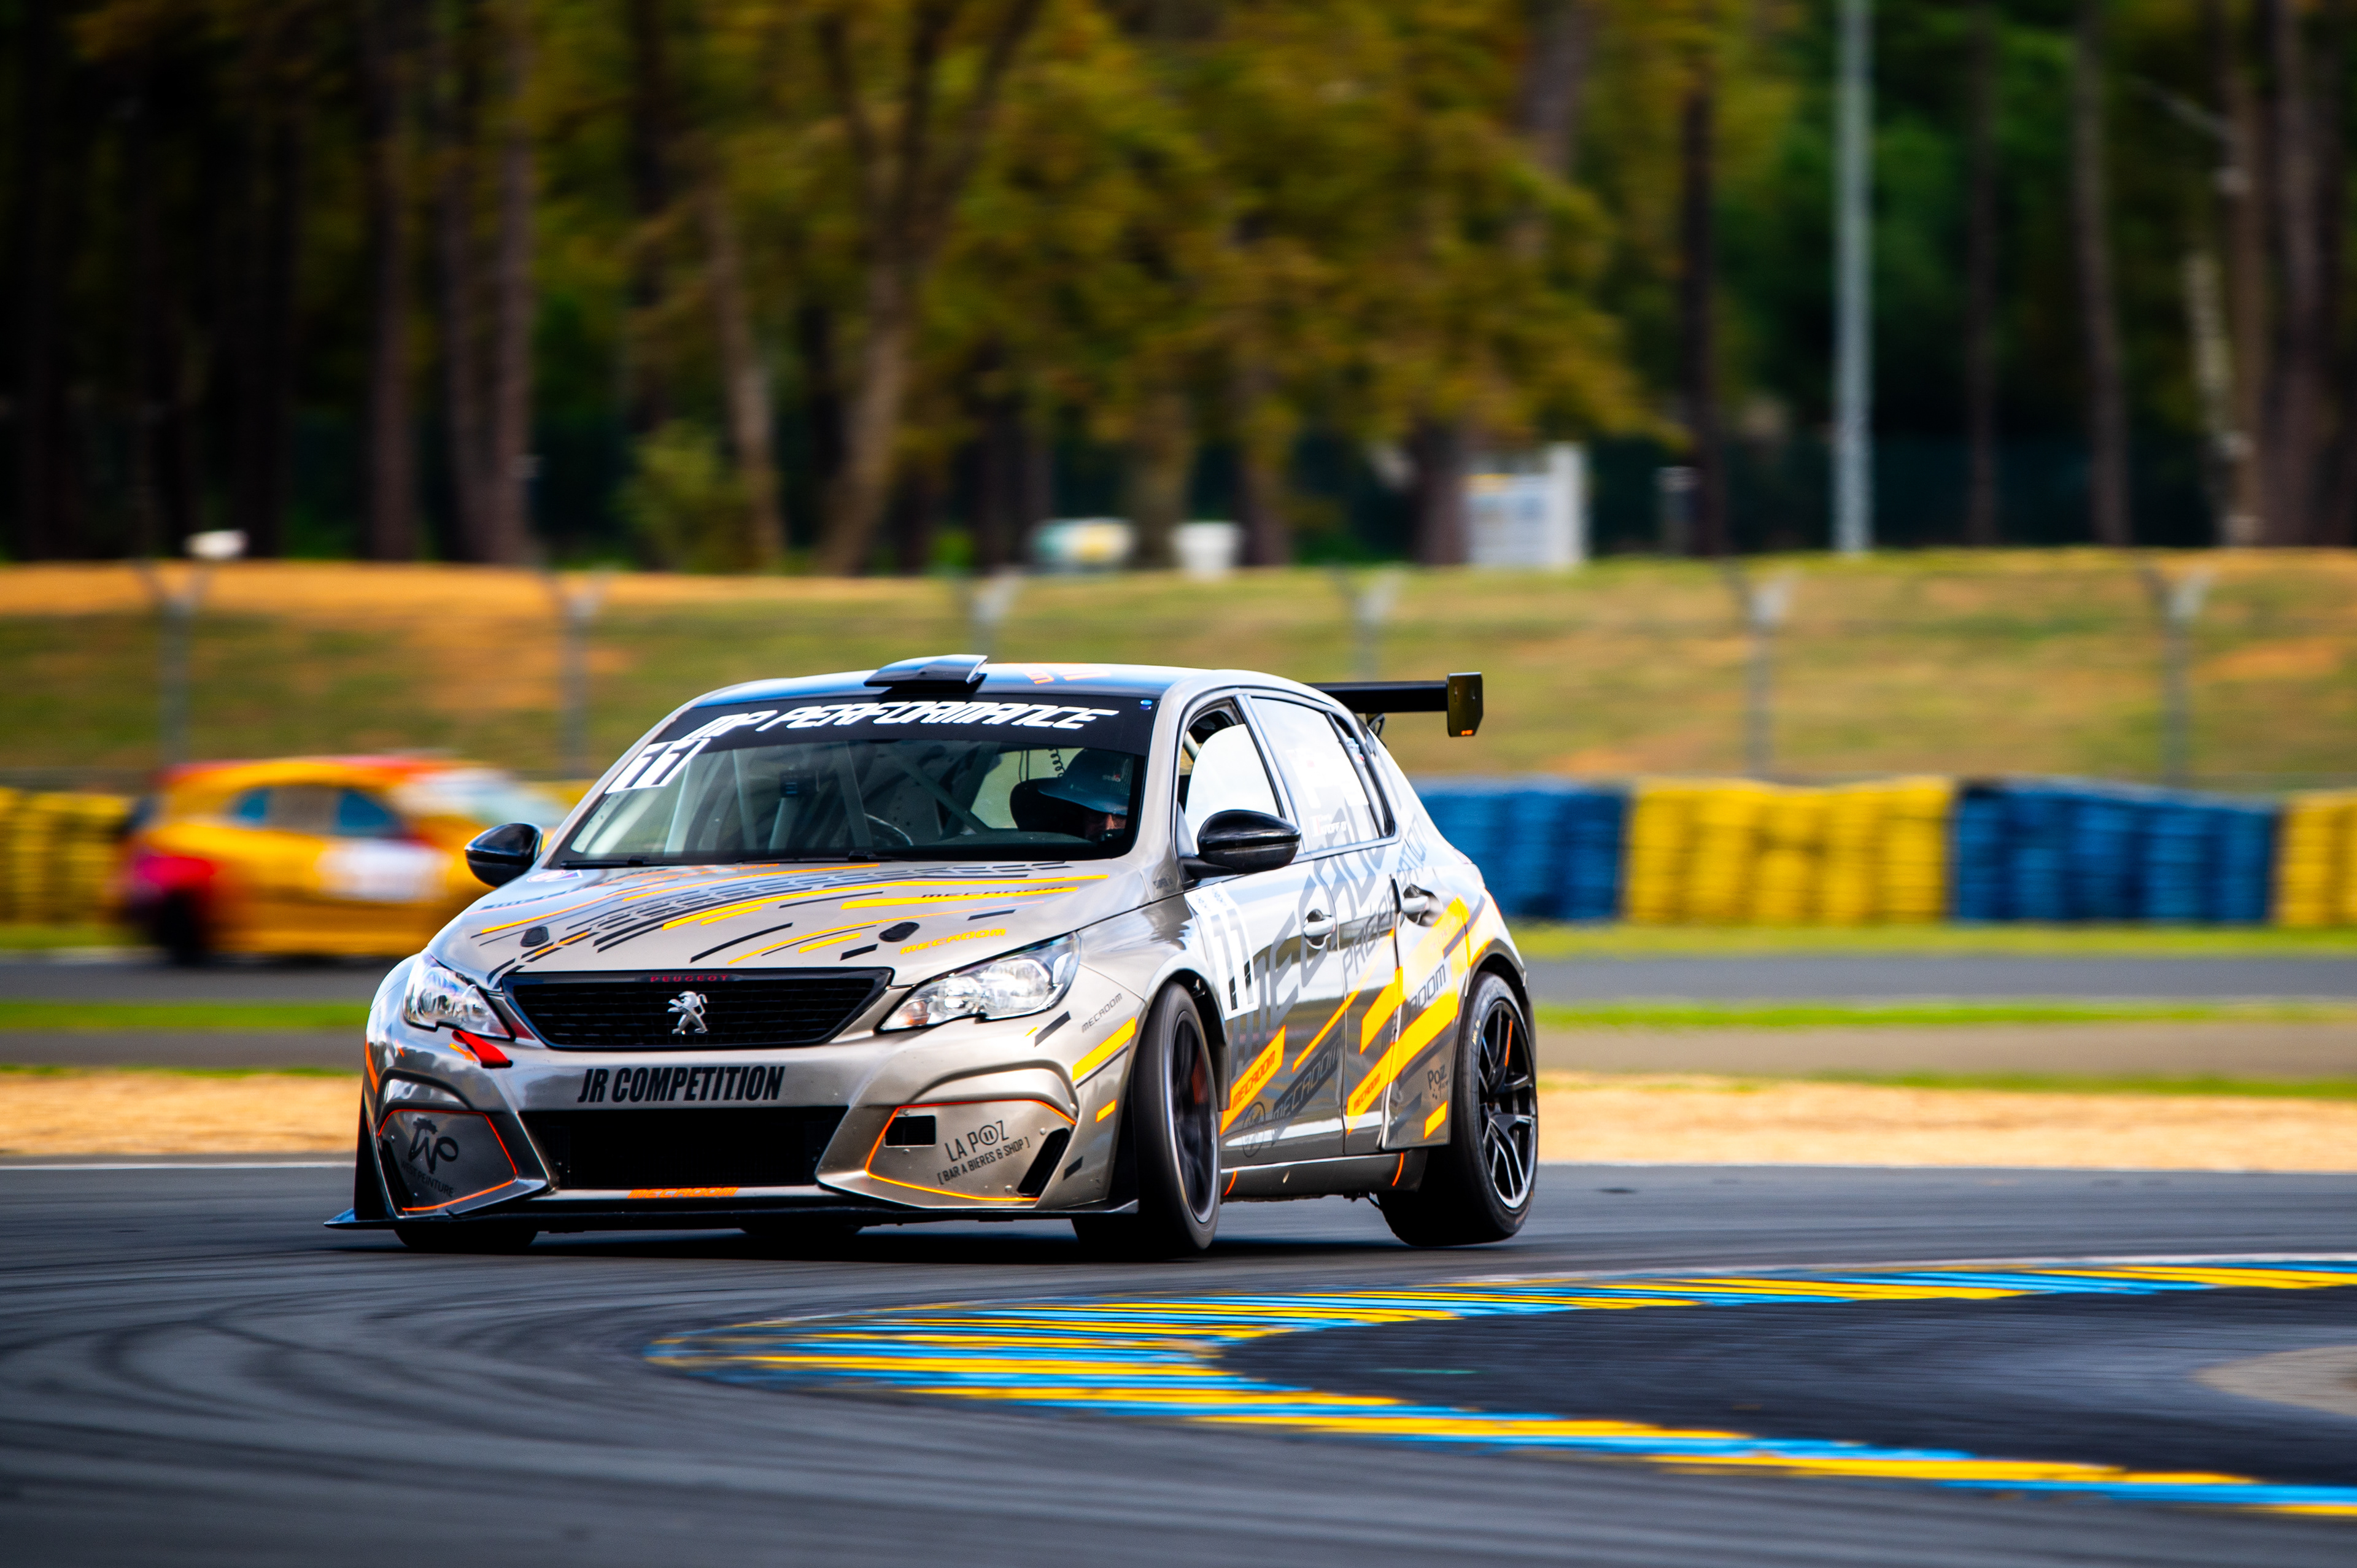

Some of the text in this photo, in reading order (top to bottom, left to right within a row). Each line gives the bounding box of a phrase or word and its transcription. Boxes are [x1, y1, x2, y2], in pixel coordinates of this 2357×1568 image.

[755, 701, 1119, 732] PERFORMANCE
[1210, 908, 1255, 1011] 11
[577, 1065, 785, 1103] JR COMPETITION
[942, 1165, 961, 1182] BAR
[996, 1148, 1003, 1159] &
[1003, 1138, 1024, 1156] SHOP
[945, 1138, 967, 1162] LA
[417, 1170, 455, 1198] PEINTURE
